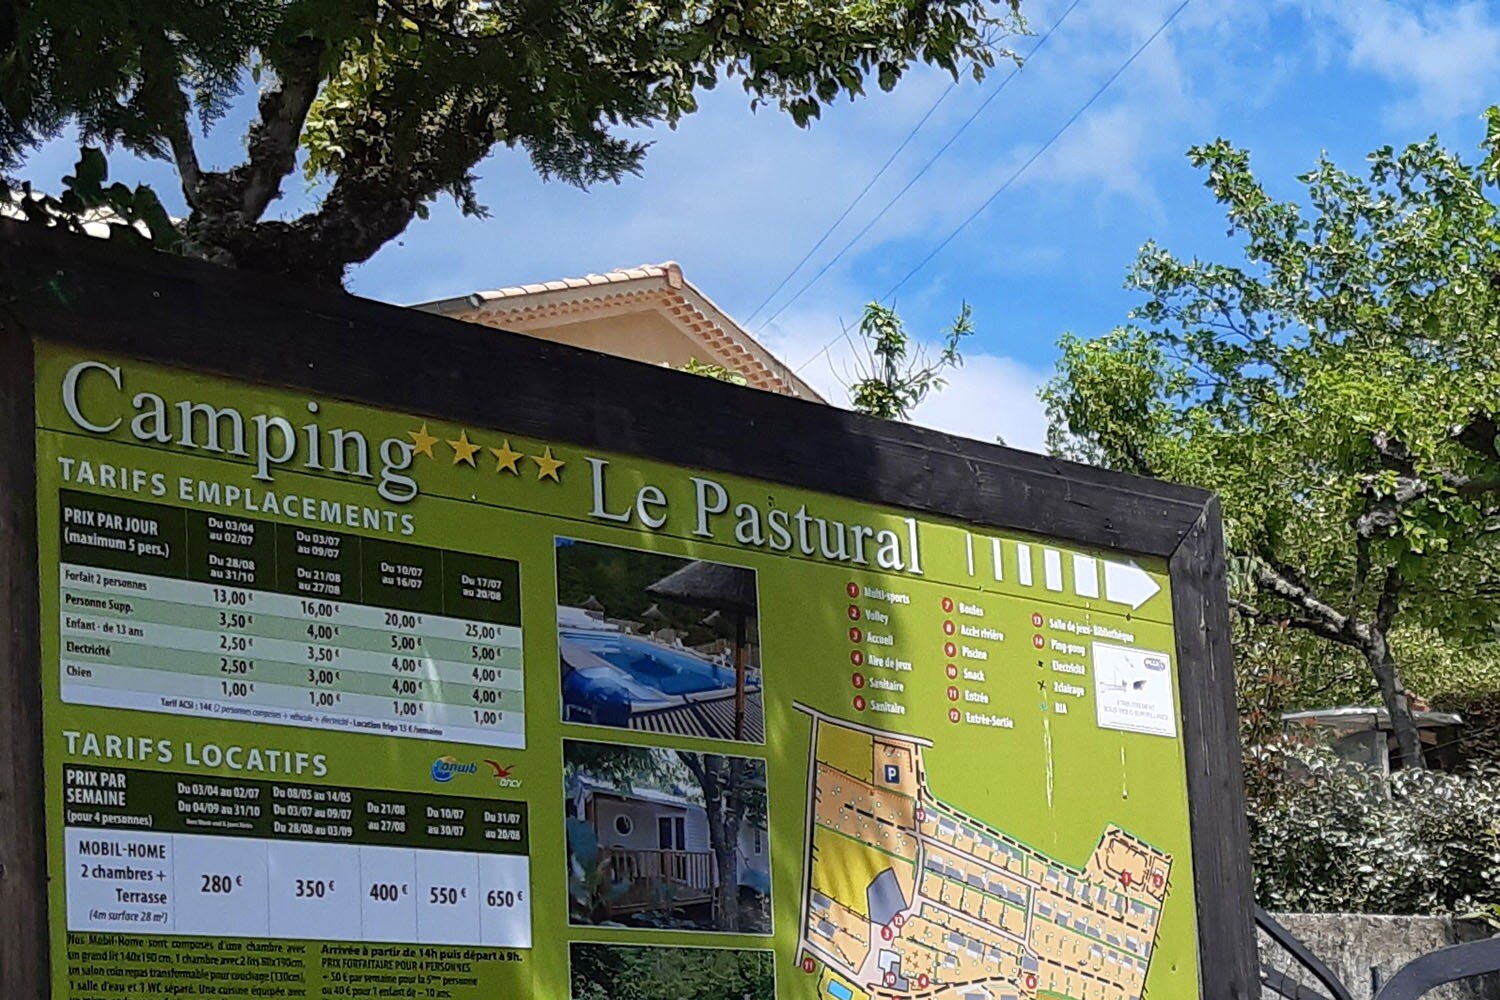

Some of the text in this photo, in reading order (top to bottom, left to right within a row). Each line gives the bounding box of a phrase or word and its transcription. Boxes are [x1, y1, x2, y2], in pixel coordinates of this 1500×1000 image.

[62, 360, 923, 574] Camping Le Pastural
[58, 456, 415, 536] TARIFS EMPLACEMENTS
[64, 507, 158, 536] PRIX PAR JOUR
[208, 517, 255, 533] Du 03/04
[64, 528, 170, 558] (maximum 5 pers.)
[209, 532, 253, 545] au 02/07
[296, 531, 340, 547] Du 03/07
[209, 554, 224, 566] Du
[297, 545, 339, 559] au 09/07
[210, 569, 255, 583] au 31/10
[297, 567, 312, 579] Du
[381, 562, 423, 577] Du 10/07
[65, 570, 147, 591] Forfait 2 personnes
[382, 575, 394, 584] au
[462, 574, 502, 590] Du 17/07
[65, 593, 134, 614] Personne Supp.
[213, 588, 246, 606] 13,00
[864, 586, 910, 605] Multi-sports
[301, 600, 332, 618] 16,00
[865, 609, 889, 625] Volley
[66, 617, 96, 631] Enfant
[102, 622, 114, 634] de
[116, 622, 126, 635] 13
[128, 626, 144, 637] ans
[219, 612, 245, 628] 3,50
[385, 612, 415, 629] 20,00
[307, 624, 332, 640] 4,00
[465, 624, 495, 640] 25,00
[867, 632, 894, 646] Accueil
[66, 641, 111, 657] Electricité
[220, 635, 246, 651] 2,50
[391, 635, 415, 650] 5,00
[307, 646, 332, 662] 3,50
[471, 646, 495, 661] 5,00
[962, 646, 988, 660] Piscine
[220, 658, 247, 674] 2,50
[391, 657, 415, 672] 4,00
[868, 654, 884, 667] Aire
[885, 658, 894, 668] de
[895, 660, 912, 672] jeux
[66, 665, 92, 678] Chien
[308, 669, 333, 685] 3,00
[472, 667, 495, 682] 4,00
[963, 668, 985, 682] Snack
[221, 681, 247, 697] 1,00
[392, 679, 416, 695] 4,00
[309, 691, 334, 707] 1,00
[472, 689, 496, 704] 4,00
[965, 690, 989, 703] Entrée
[393, 701, 417, 717] 1,00
[870, 700, 906, 715] Sanitaire
[473, 710, 496, 725] 1,00
[966, 712, 1014, 729] Entrée-Sortie
[62, 730, 328, 778] TARIFS LOCATIFS
[66, 769, 126, 788] PRIX PAR
[66, 787, 126, 807] SEMAINE
[177, 782, 260, 799] Du 03/04 au 02/07
[273, 787, 286, 798] Du
[314, 791, 326, 801] au
[178, 800, 261, 817] Du 04/09 au 31/10
[273, 804, 352, 820] Du 03/07 au 09/07
[367, 802, 406, 816] Du 21/08
[427, 807, 464, 820] Du 10/07
[67, 811, 153, 827] (pour 4 personnes)
[368, 821, 406, 833] au 27/08
[274, 821, 286, 832] Du
[315, 826, 326, 835] au
[327, 825, 352, 837] 03/09
[428, 825, 464, 837] au 30/07
[79, 840, 166, 859] MOBIL-HOME
[80, 864, 167, 882] 2 chambres +
[201, 875, 232, 893] 280
[295, 880, 325, 898] 350
[115, 888, 167, 904] Terrasse
[370, 884, 399, 902] 400
[430, 887, 458, 905] 550
[487, 890, 514, 908] 650
[89, 910, 107, 921] (4m
[108, 911, 138, 922] surface
[140, 911, 152, 922] 28
